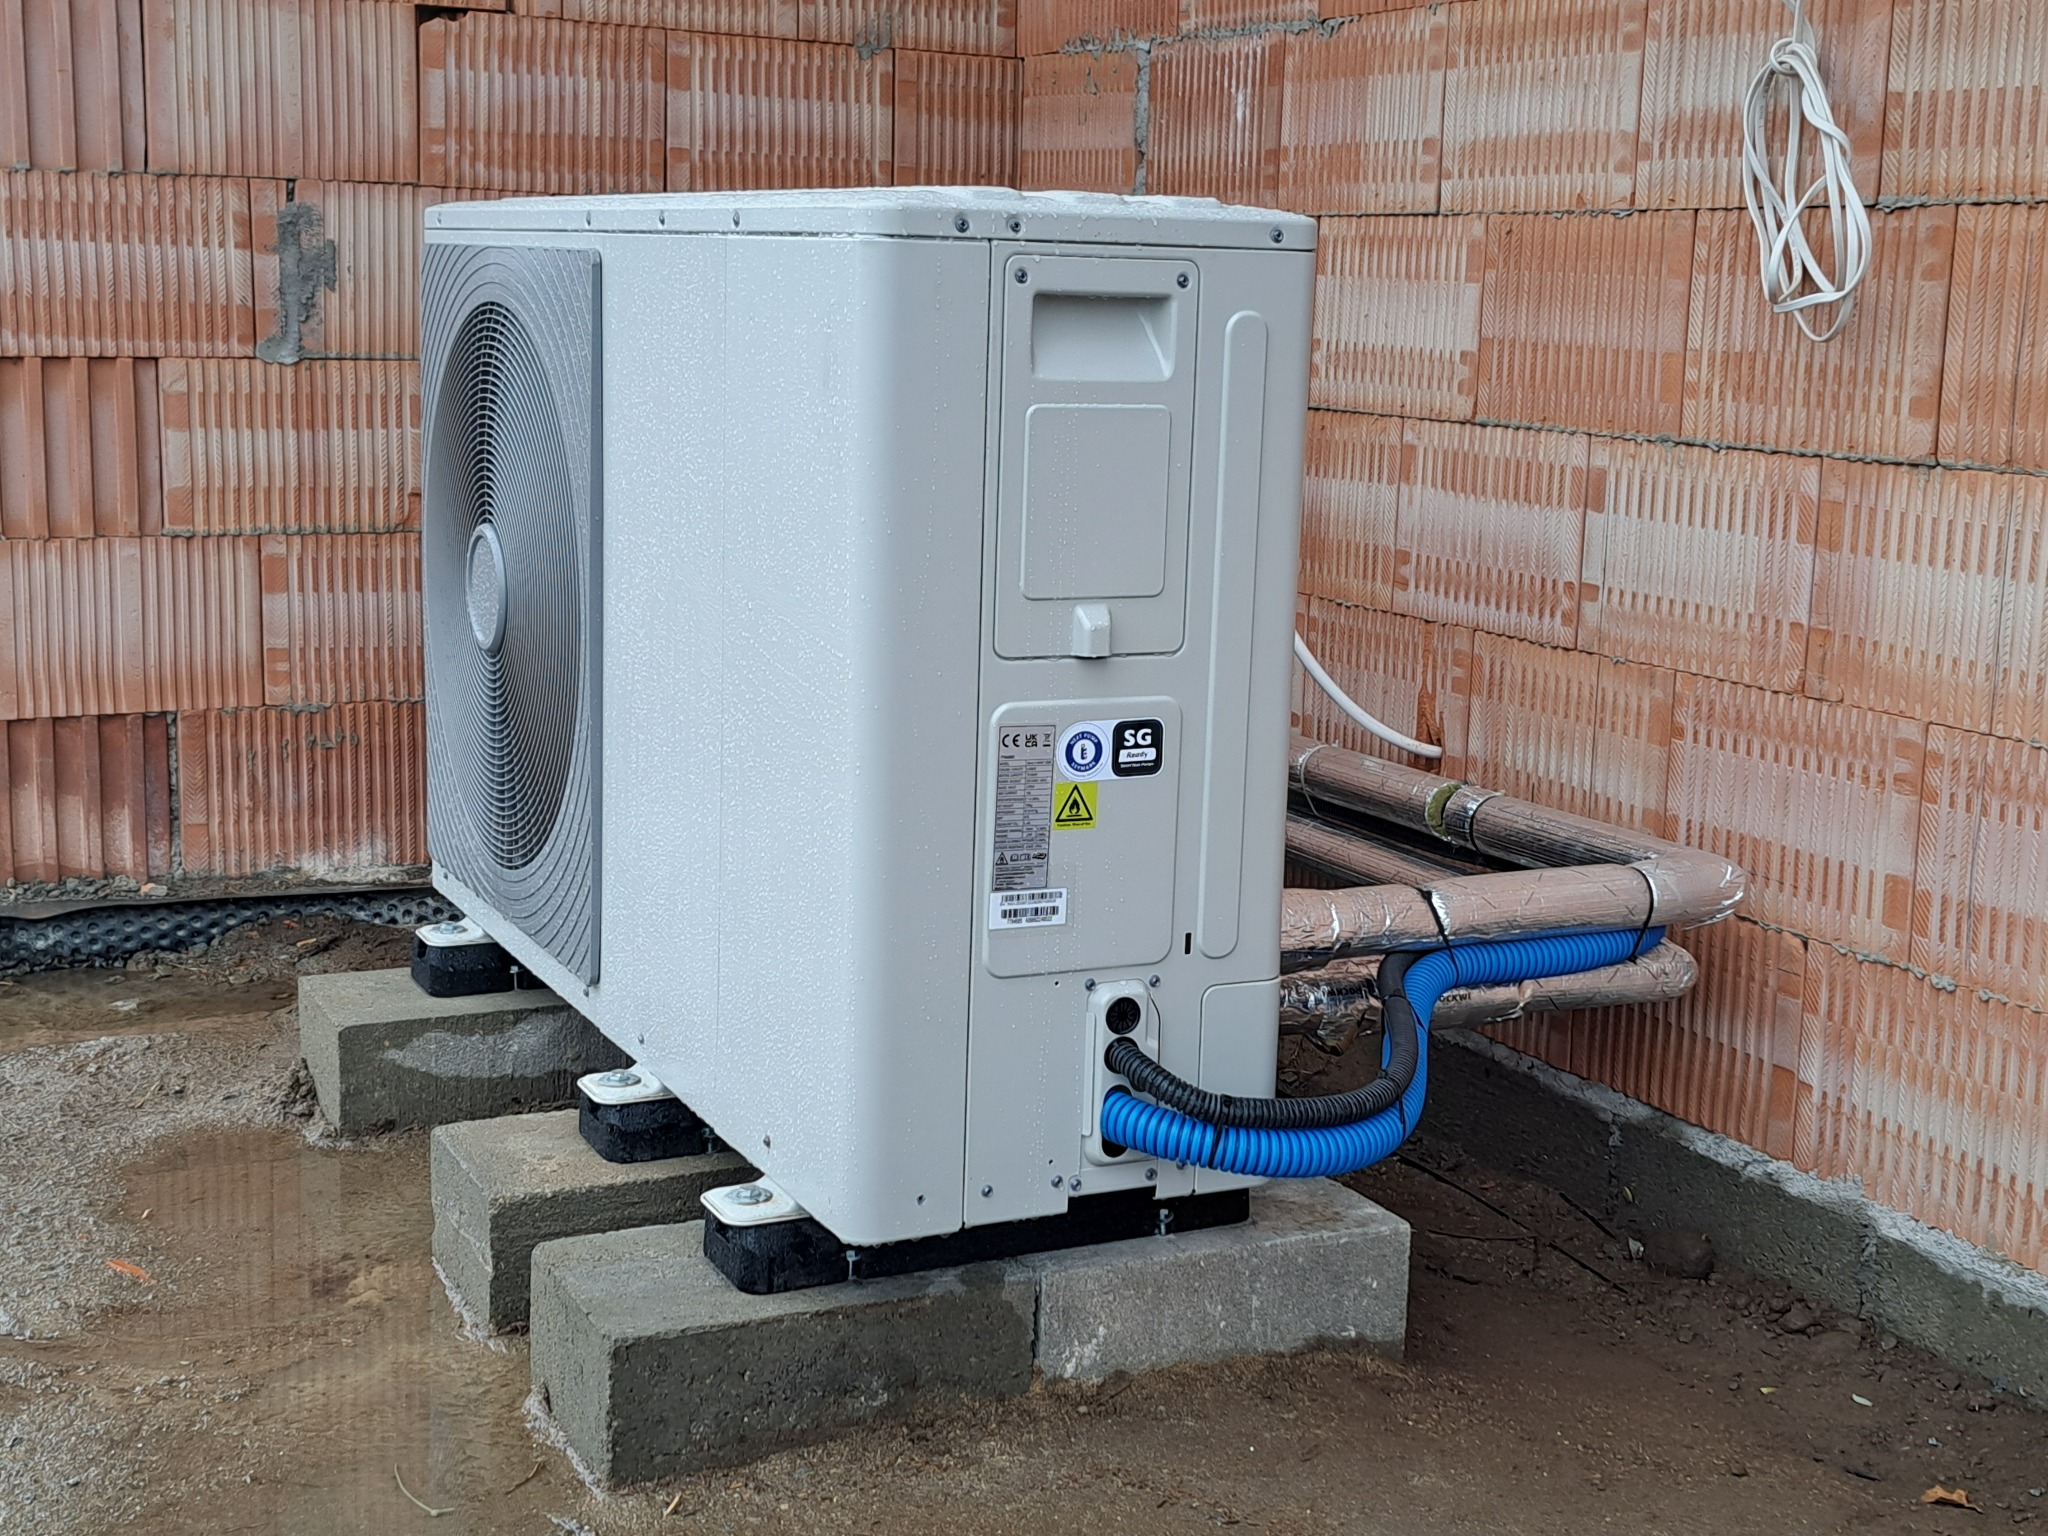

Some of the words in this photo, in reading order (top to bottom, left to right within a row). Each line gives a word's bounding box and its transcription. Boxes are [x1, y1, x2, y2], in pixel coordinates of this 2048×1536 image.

[1001, 733, 1021, 748] CE
[1025, 733, 1038, 741] UK
[1123, 728, 1152, 747] SG
[1024, 740, 1038, 748] CA
[1126, 751, 1148, 759] Ready
